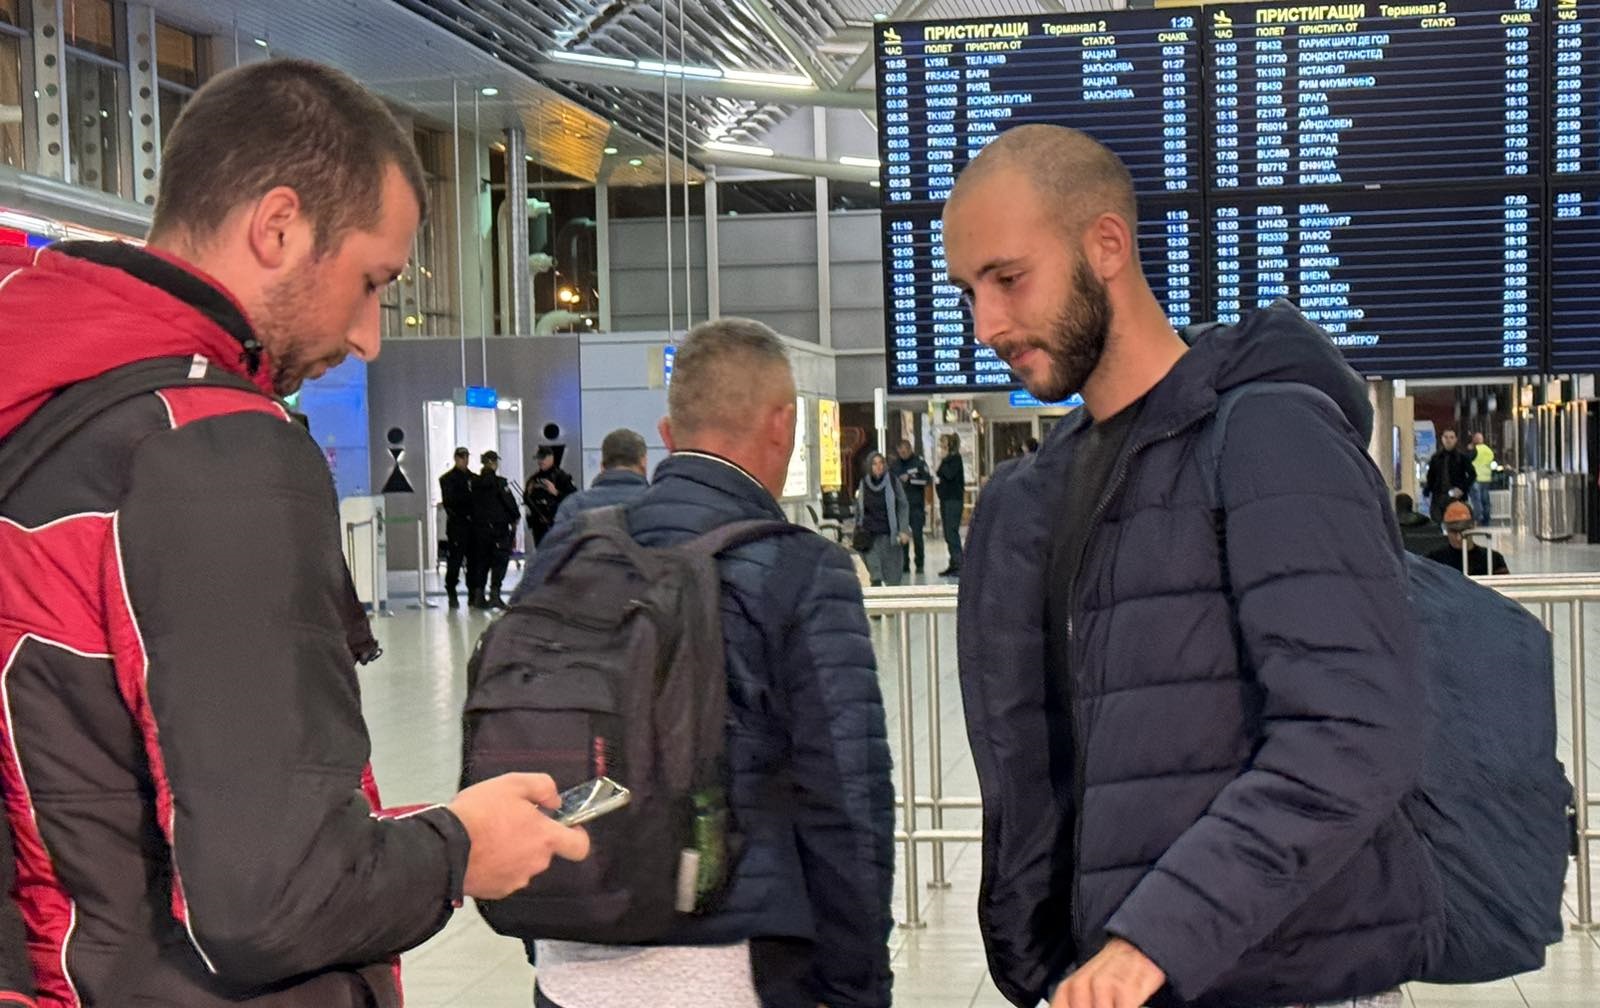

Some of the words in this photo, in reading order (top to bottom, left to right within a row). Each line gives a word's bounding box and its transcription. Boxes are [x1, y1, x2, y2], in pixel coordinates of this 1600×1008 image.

[1256, 4, 1365, 23] ПРИСТИГАЩИ
[1380, 5, 1436, 18] Терминал
[1439, 2, 1446, 13] 2
[1559, 11, 1577, 19] ЧАС
[1171, 17, 1193, 28] 1:29
[1421, 18, 1455, 28] СТАТУС
[924, 22, 1028, 40] ПРИСТИГАЩИ
[1042, 22, 1096, 35] Терминал
[1099, 21, 1106, 32] 2
[1256, 27, 1285, 36] ПОЛЕТ
[1299, 24, 1346, 34] ПРИСТИГА
[1345, 23, 1357, 32] ОТ
[1505, 27, 1529, 37] 14:00
[1557, 24, 1582, 34] 21:35
[1215, 30, 1232, 38] ЧАС
[966, 42, 1009, 51] ПРИСТИГА
[1010, 41, 1021, 49] ОТ
[1082, 36, 1115, 46] СТАТУС
[1505, 41, 1529, 51] 14:25
[1557, 38, 1582, 48] 21:40
[885, 47, 902, 55] ЧАС
[925, 44, 953, 53] ПОЛЕТ
[1215, 42, 1237, 52] 14:00
[1215, 56, 1238, 66] 14:25
[1505, 54, 1529, 64] 14:35
[1557, 51, 1582, 61] 22:30
[885, 59, 907, 69] 19:55
[1162, 59, 1185, 69] 01:27
[1215, 69, 1238, 79] 14:35
[1505, 68, 1529, 78] 14:40
[1557, 65, 1582, 75] 22:50
[885, 72, 907, 82] 00:55
[1215, 83, 1238, 93] 14:40
[1505, 82, 1529, 92] 14:50
[1557, 79, 1582, 89] 23:00
[885, 86, 908, 96] 01:40
[1215, 97, 1238, 106] 14:50
[1505, 96, 1529, 106] 15:15
[1557, 93, 1581, 103] 23:30
[886, 99, 908, 109] 03:05
[886, 112, 909, 122] 08:35
[1216, 110, 1238, 120] 15:15
[1505, 110, 1529, 120] 15:20
[1556, 107, 1581, 117] 23:35
[887, 125, 909, 135] 09:00
[1216, 124, 1238, 134] 15:20
[1505, 123, 1528, 133] 15:35
[1556, 121, 1581, 131] 23:50
[887, 138, 910, 148] 09:05
[1216, 137, 1238, 147] 15:35
[1505, 137, 1528, 147] 17:00
[1556, 134, 1581, 144] 23:55
[888, 152, 910, 162] 09:05
[1216, 151, 1239, 160] 17:00
[1505, 151, 1528, 161] 17:10
[1556, 148, 1581, 158] 23:55
[888, 165, 911, 175] 09:25
[1216, 164, 1239, 174] 17:10
[1505, 164, 1528, 174] 17:45
[1556, 162, 1581, 172] 23:55
[888, 178, 911, 188] 09:35
[1216, 177, 1239, 187] 17:45
[890, 191, 912, 201] 10:10
[1166, 210, 1189, 220] 11:10
[891, 221, 913, 230] 11:10
[1167, 223, 1189, 233] 11:15
[892, 234, 914, 243] 11:15
[1167, 237, 1189, 247] 12:00
[892, 247, 914, 257] 12:00
[1167, 250, 1189, 260] 12:05
[893, 259, 914, 269] 12:05
[1167, 263, 1190, 273] 12:10
[893, 273, 915, 283] 12:10
[1167, 276, 1190, 286] 12:15
[894, 286, 916, 296] 12:15
[1167, 289, 1190, 299] 12:35
[894, 298, 916, 308] 12:35
[1168, 302, 1190, 312] 13:15
[895, 312, 916, 322] 13:15
[1168, 316, 1191, 326] 13:20
[895, 325, 917, 334] 13:20
[895, 337, 917, 347] 13:25
[896, 350, 918, 360] 13:55
[896, 363, 918, 373] 13:55
[897, 376, 919, 385] 14:00
